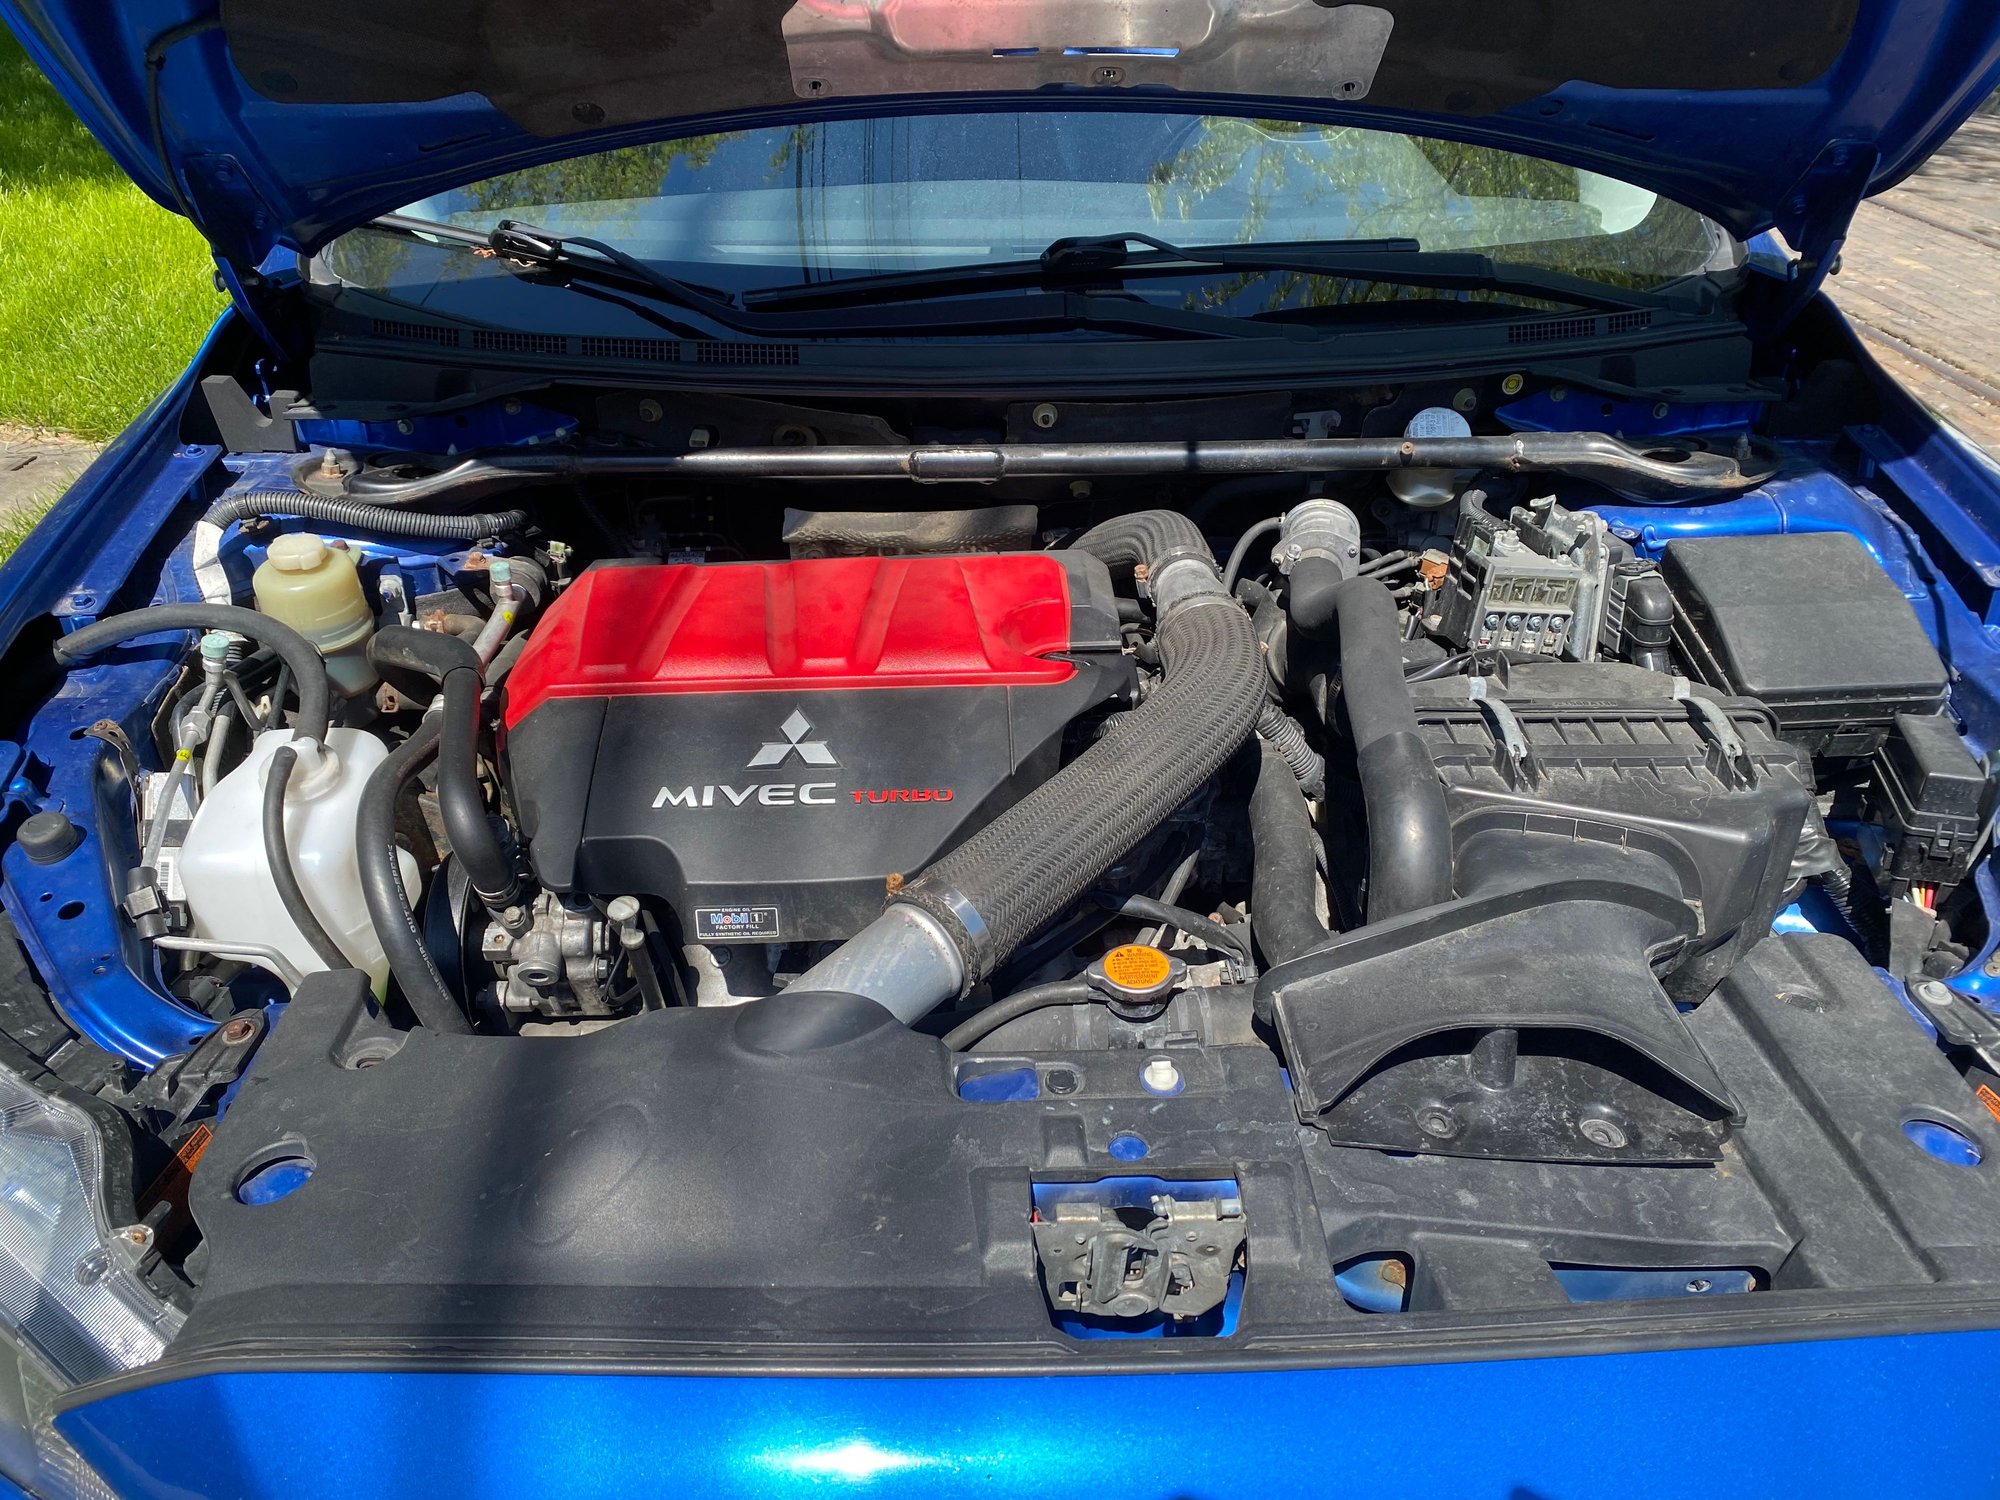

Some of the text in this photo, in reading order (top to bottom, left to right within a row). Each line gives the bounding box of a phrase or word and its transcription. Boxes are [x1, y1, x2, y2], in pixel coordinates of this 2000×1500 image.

[651, 782, 955, 809] MIVEC TURBO
[710, 912, 749, 925] Mobil
